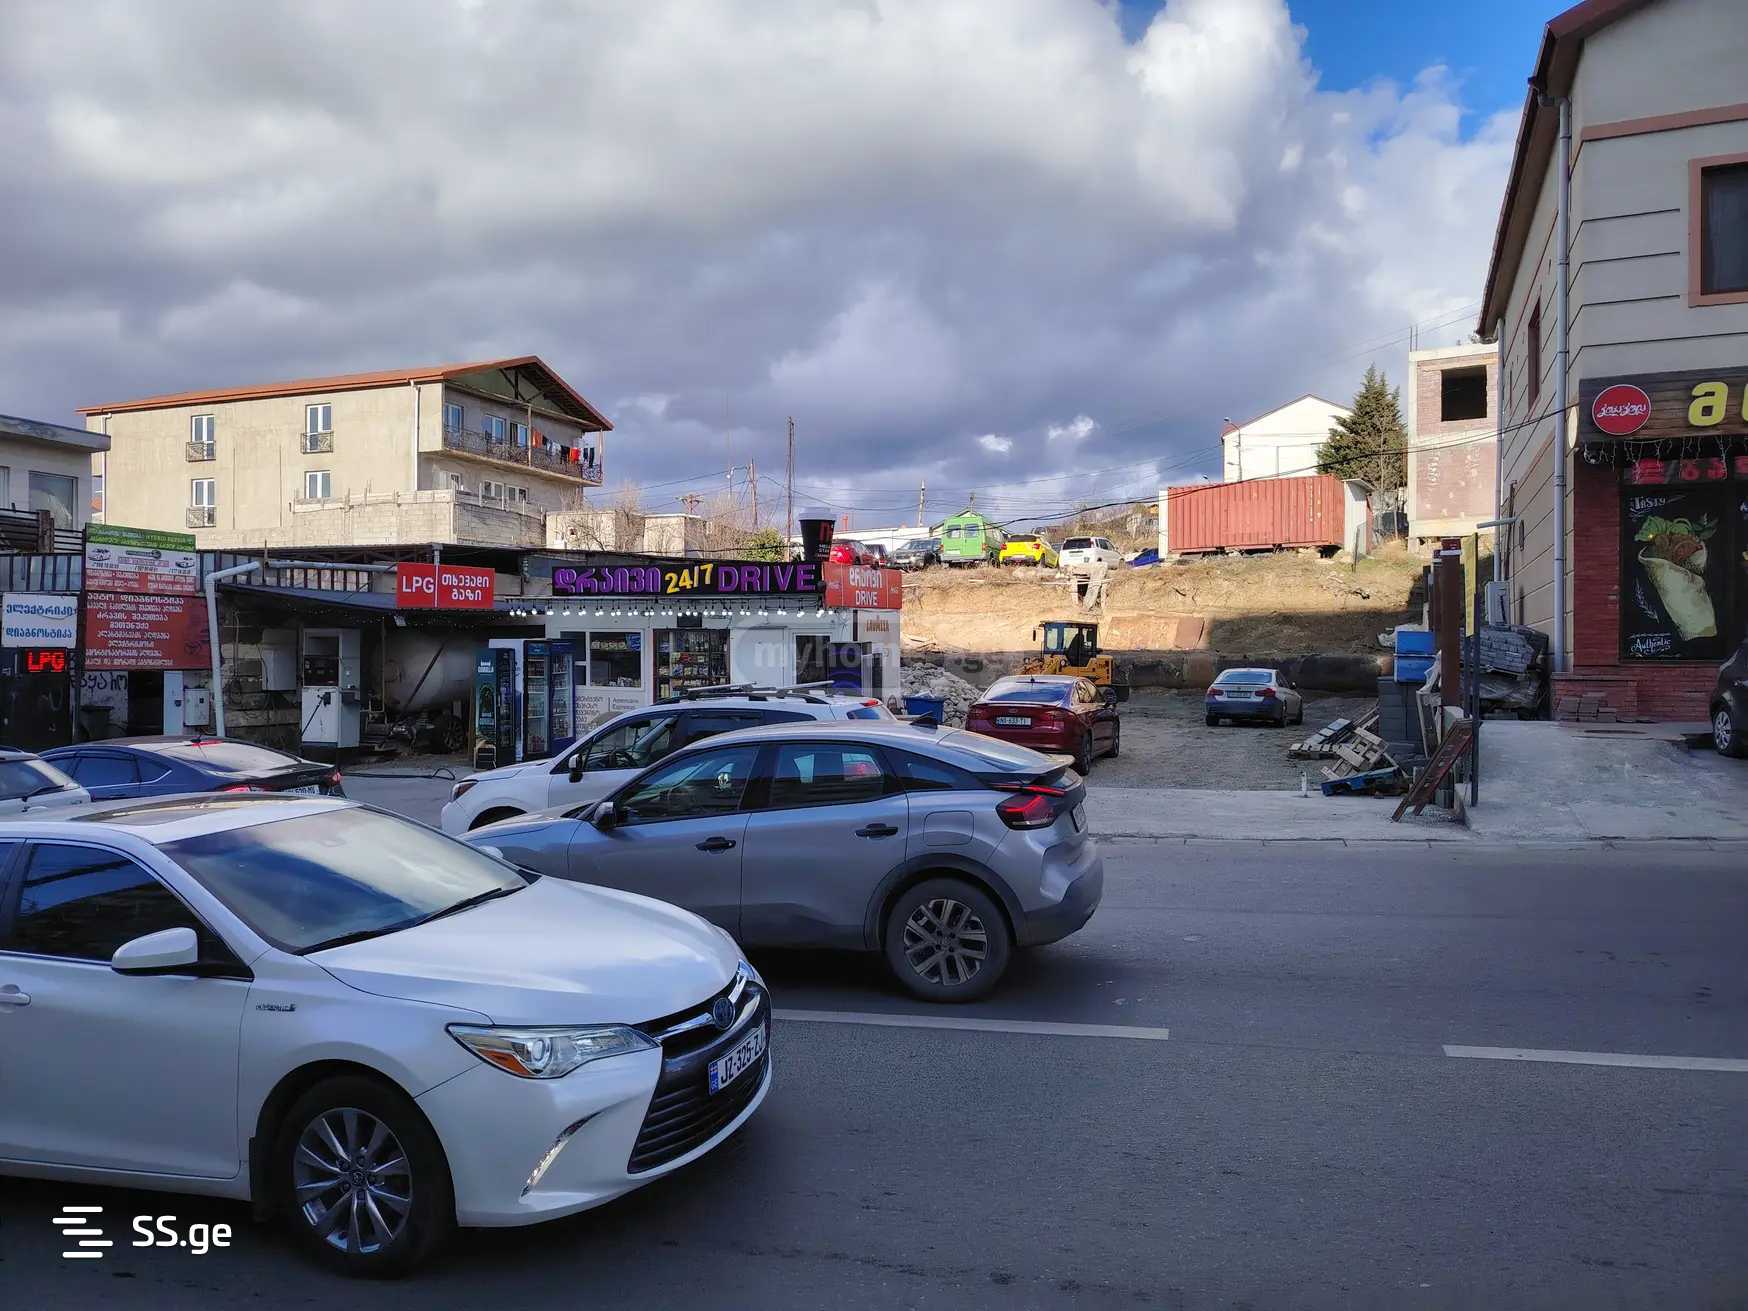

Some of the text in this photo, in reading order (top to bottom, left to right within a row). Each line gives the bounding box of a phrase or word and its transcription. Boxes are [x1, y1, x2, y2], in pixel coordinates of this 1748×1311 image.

[402, 576, 434, 593] LPG
[441, 574, 489, 588] თხევადი
[554, 568, 660, 593] დრაივი
[664, 565, 713, 594] 24/7
[718, 564, 815, 592] DRIVE
[452, 589, 482, 601] გაზი
[855, 591, 878, 606] DRIVE
[6, 627, 72, 638] დიაგნოსტიკა
[27, 651, 65, 672] LPG
